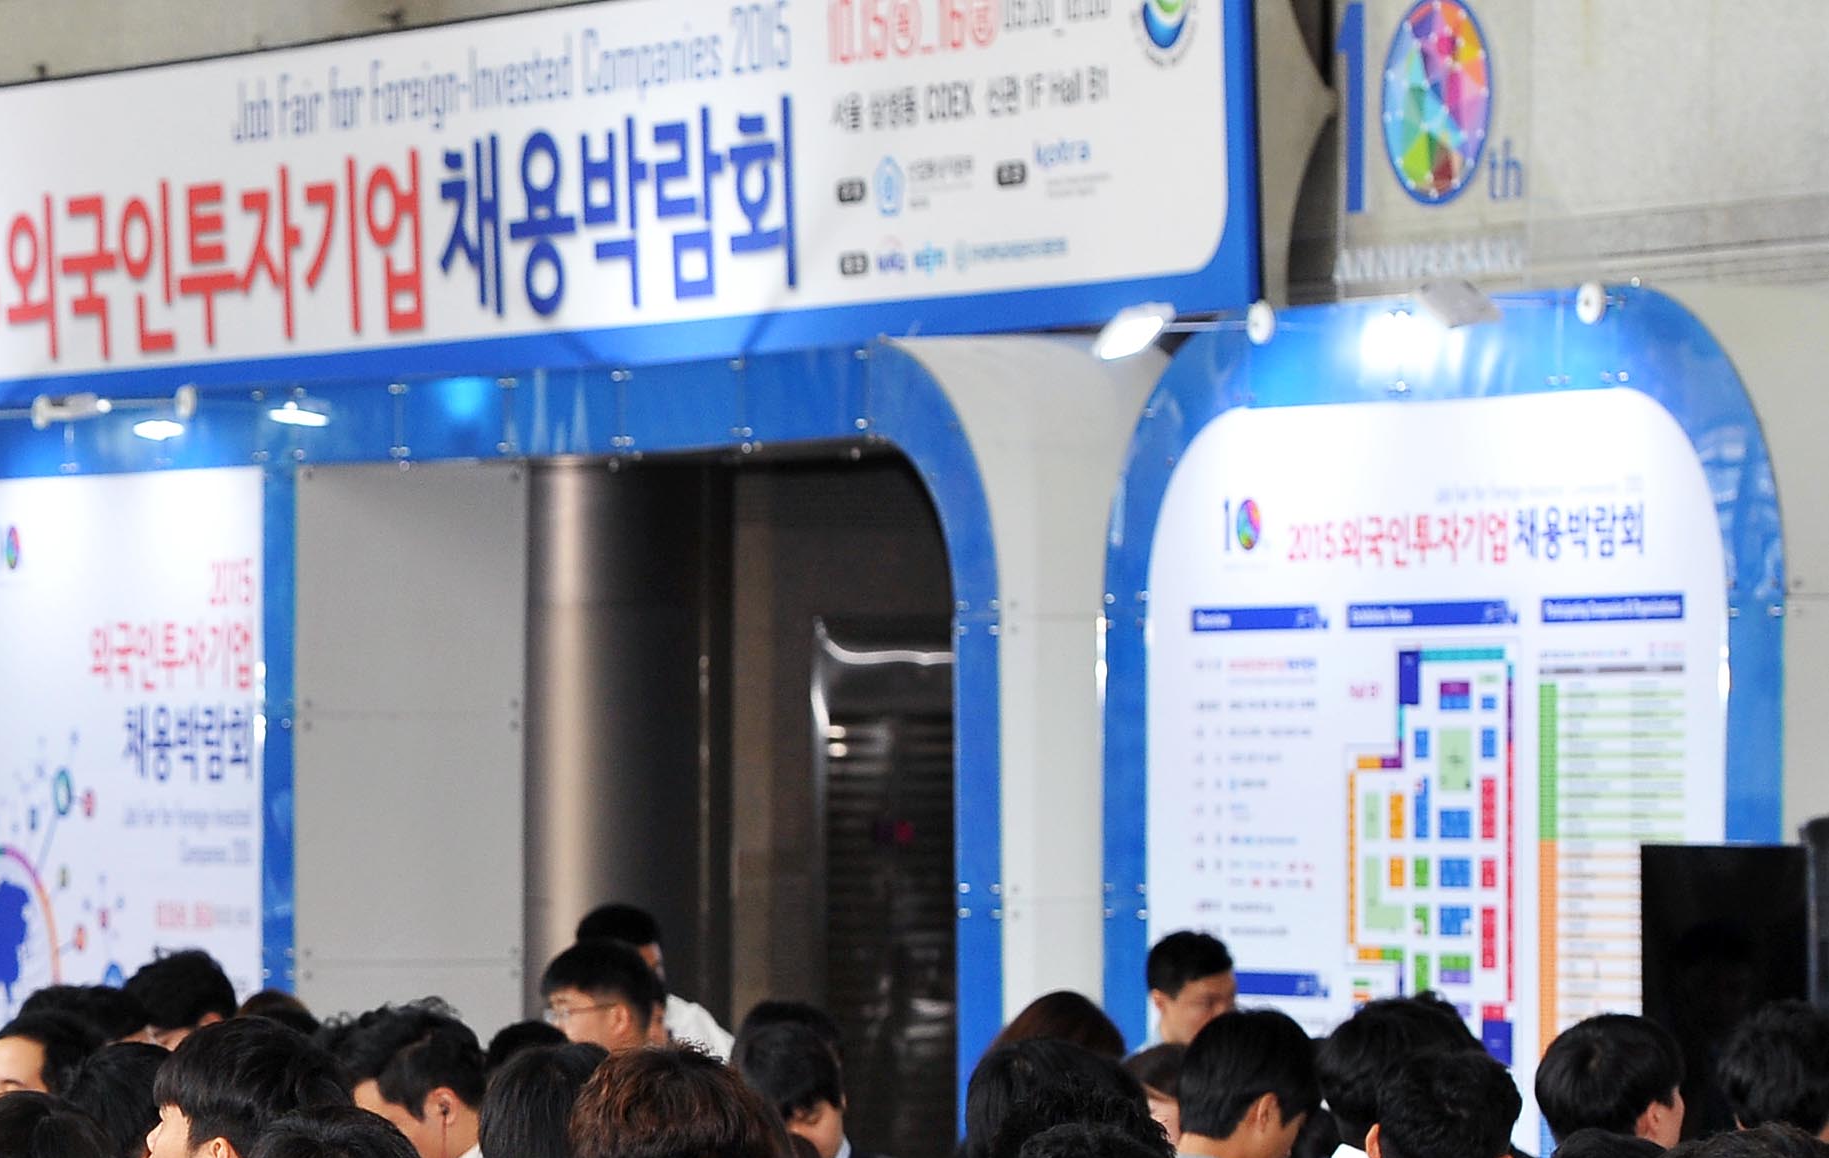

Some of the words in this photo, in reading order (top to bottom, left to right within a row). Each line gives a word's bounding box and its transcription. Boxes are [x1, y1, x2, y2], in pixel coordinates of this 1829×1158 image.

[232, 78, 274, 142] Job
[278, 73, 323, 137] Fair
[330, 65, 365, 129] for
[581, 28, 722, 102] Companies
[730, 0, 793, 74] 2015
[924, 79, 975, 123] COEX
[440, 94, 799, 318] 채용박람회
[1513, 502, 1646, 561] 채용박람회
[208, 558, 255, 606] 2015
[90, 620, 253, 692] 외국인투자기업
[122, 704, 253, 783] 채용박람회
